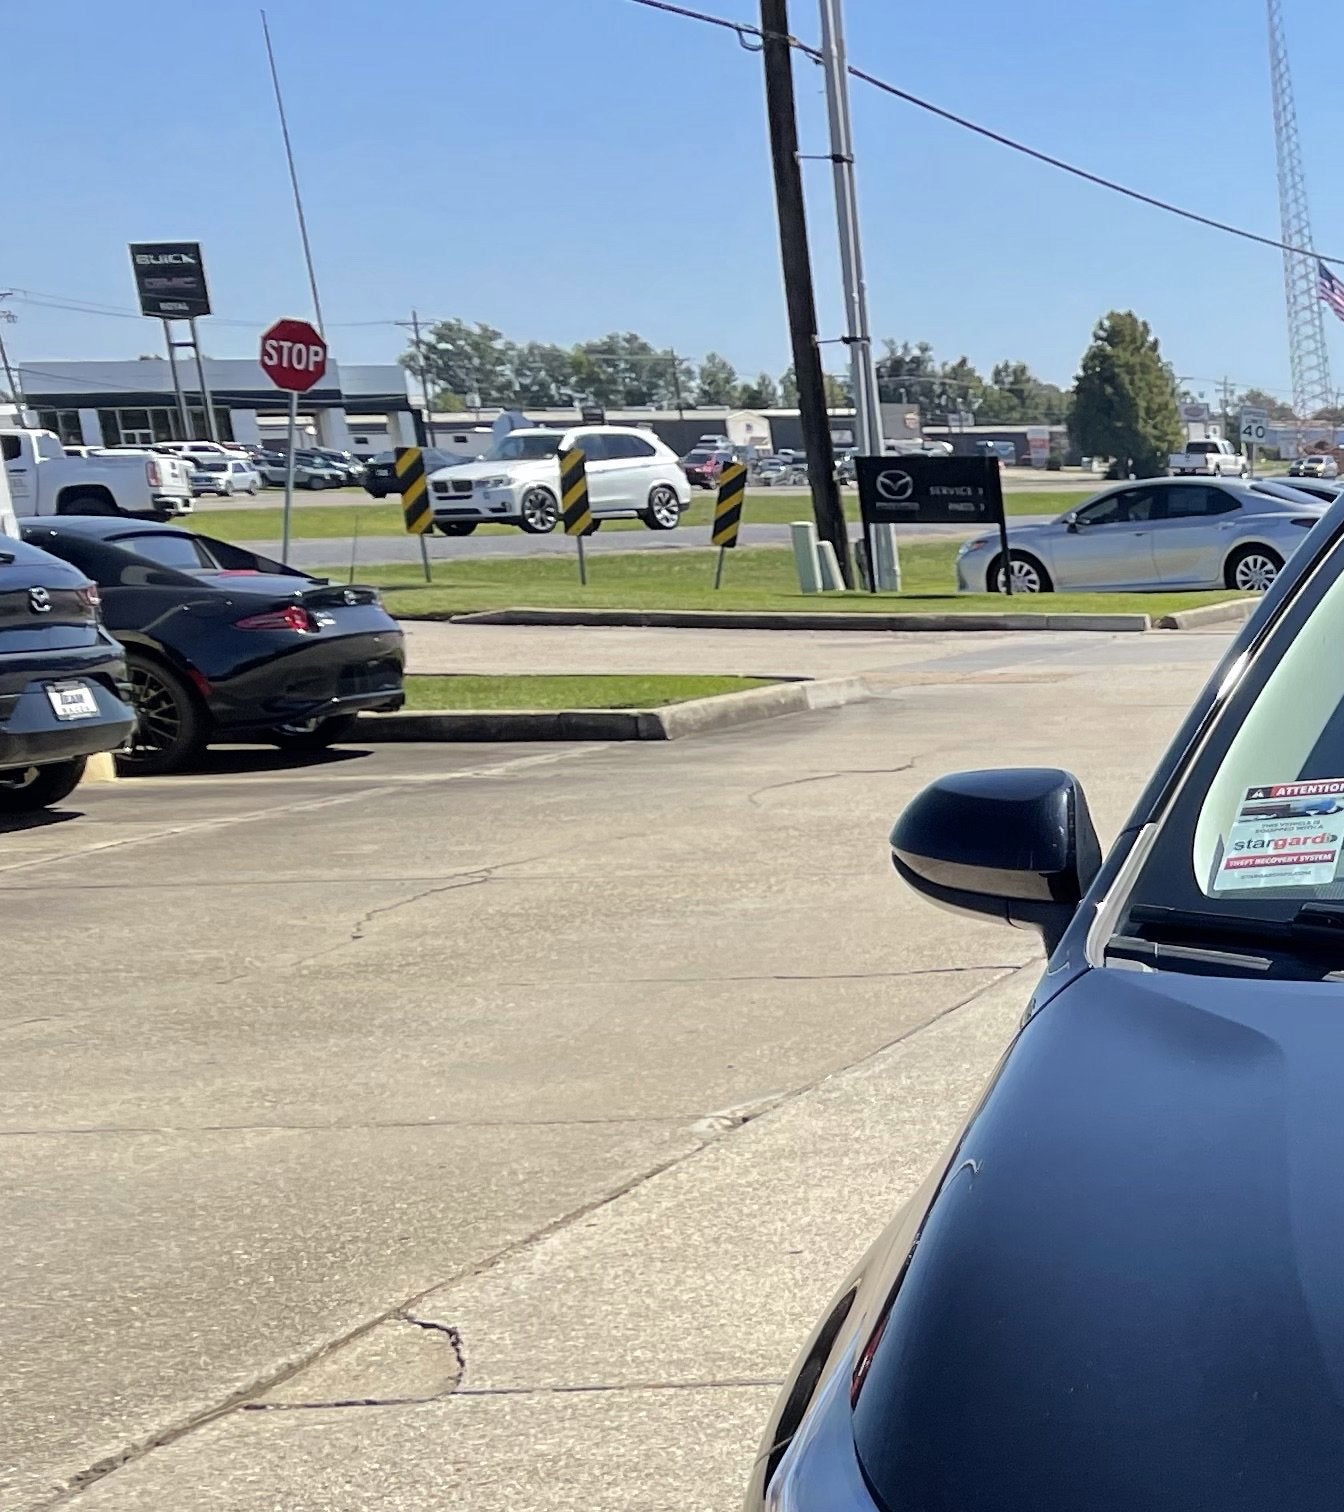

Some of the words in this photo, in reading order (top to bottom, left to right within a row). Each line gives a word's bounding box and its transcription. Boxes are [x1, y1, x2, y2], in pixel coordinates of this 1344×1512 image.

[135, 253, 196, 265] BUICK
[264, 339, 324, 371] STOP
[1243, 424, 1266, 439] 40
[929, 485, 972, 495] SERVICE
[1255, 855, 1299, 865] RECOVERY
[1299, 853, 1333, 862] SYSTEM
